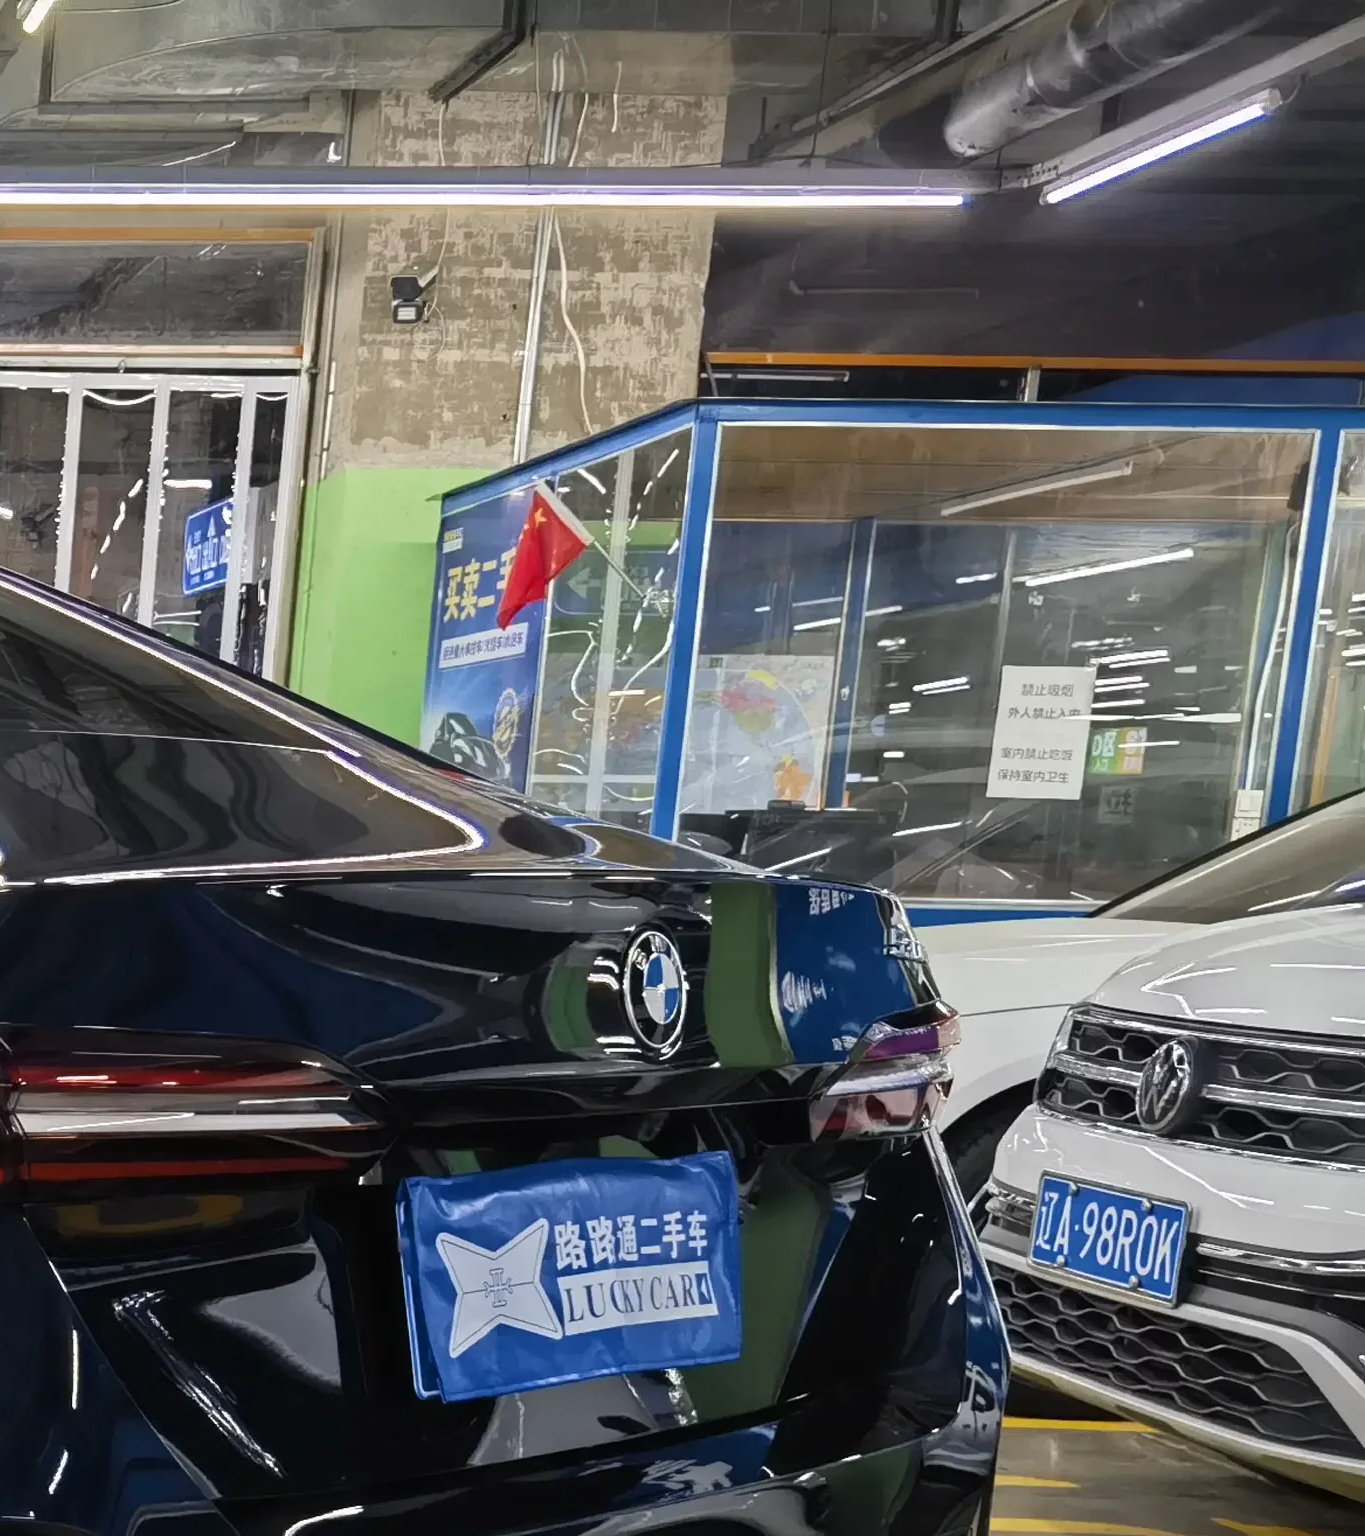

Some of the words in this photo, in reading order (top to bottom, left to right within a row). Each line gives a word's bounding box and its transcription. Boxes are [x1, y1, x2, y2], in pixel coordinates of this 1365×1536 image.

[1021, 683, 1074, 698] 禁止吸烟
[1000, 746, 1073, 761] 室内禁止吃饭
[997, 768, 1070, 784] 保持室内卫生
[554, 1210, 709, 1271] 路路通二手车
[565, 1278, 645, 1323] LUCKY
[649, 1273, 697, 1311] CAR
